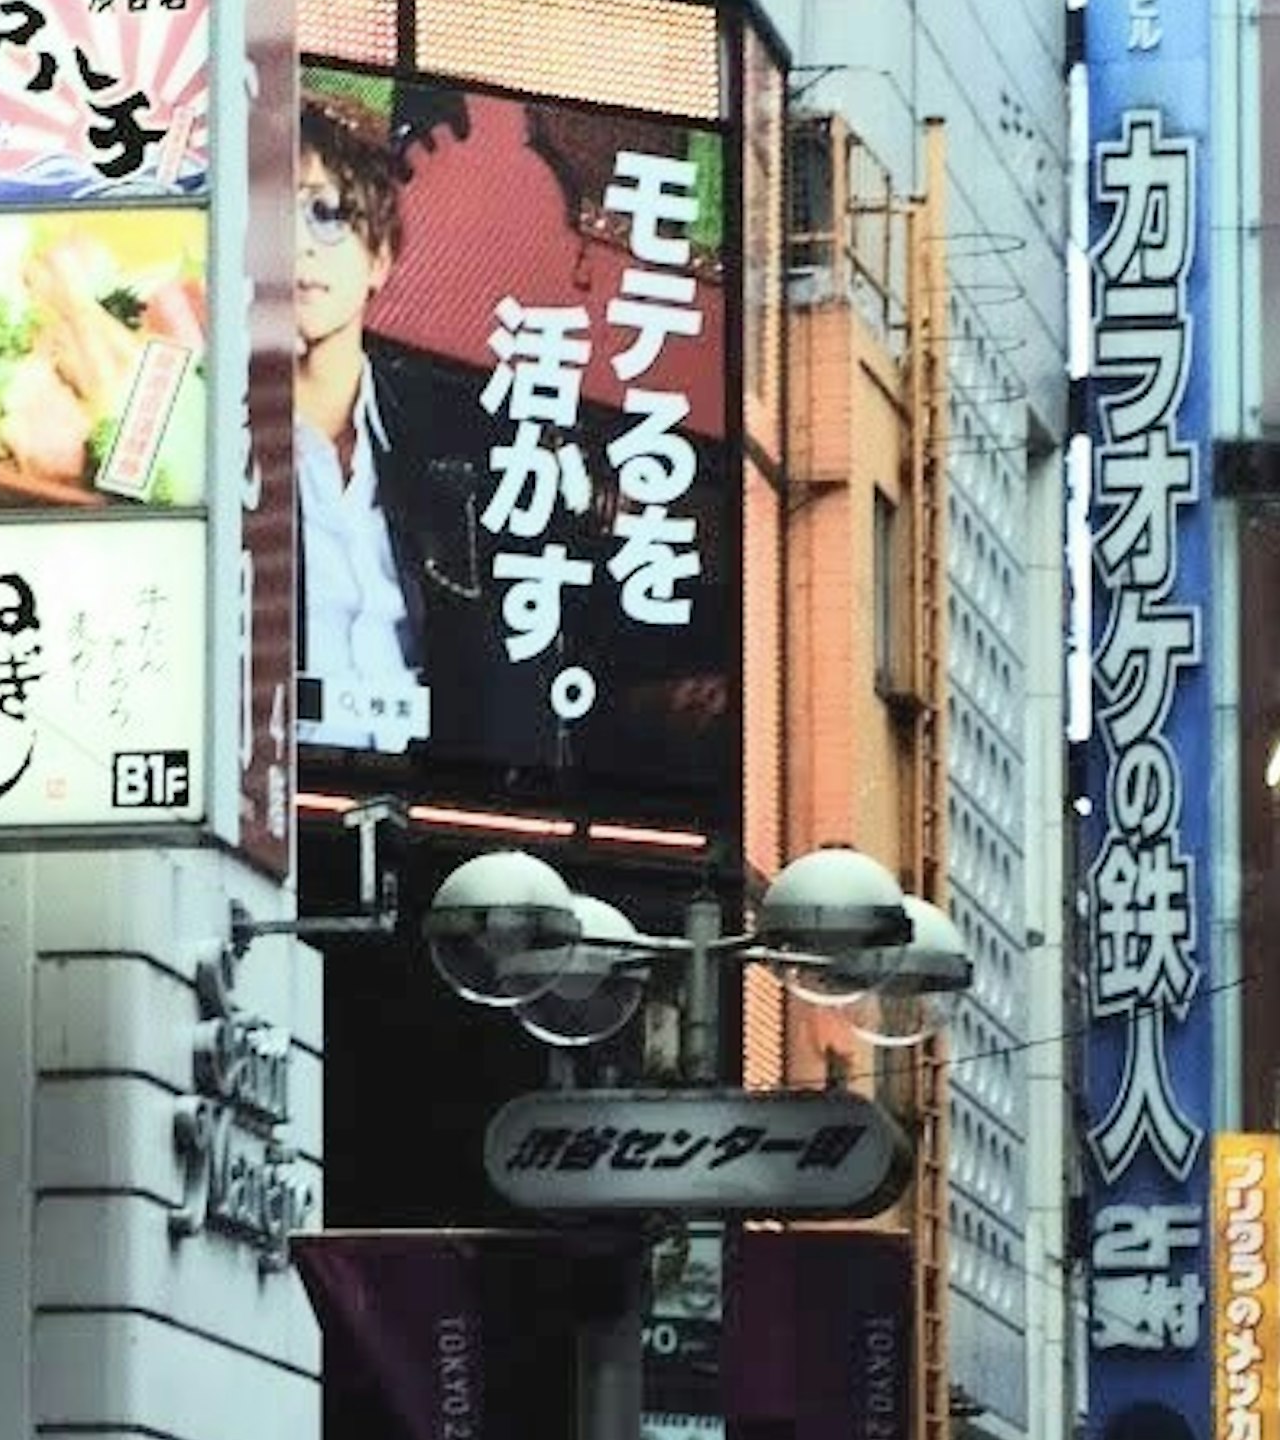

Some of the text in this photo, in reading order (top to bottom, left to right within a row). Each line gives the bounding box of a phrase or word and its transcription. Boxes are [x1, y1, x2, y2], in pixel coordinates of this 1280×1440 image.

[604, 150, 703, 626] モテるを
[478, 294, 598, 721] 活かす。
[1090, 109, 1204, 1185] カラオケの鉄人
[116, 754, 190, 807] B1F
[1092, 1203, 1204, 1271] 2F
[437, 1315, 470, 1418] TOKYO
[864, 1315, 895, 1417] TOKYO
